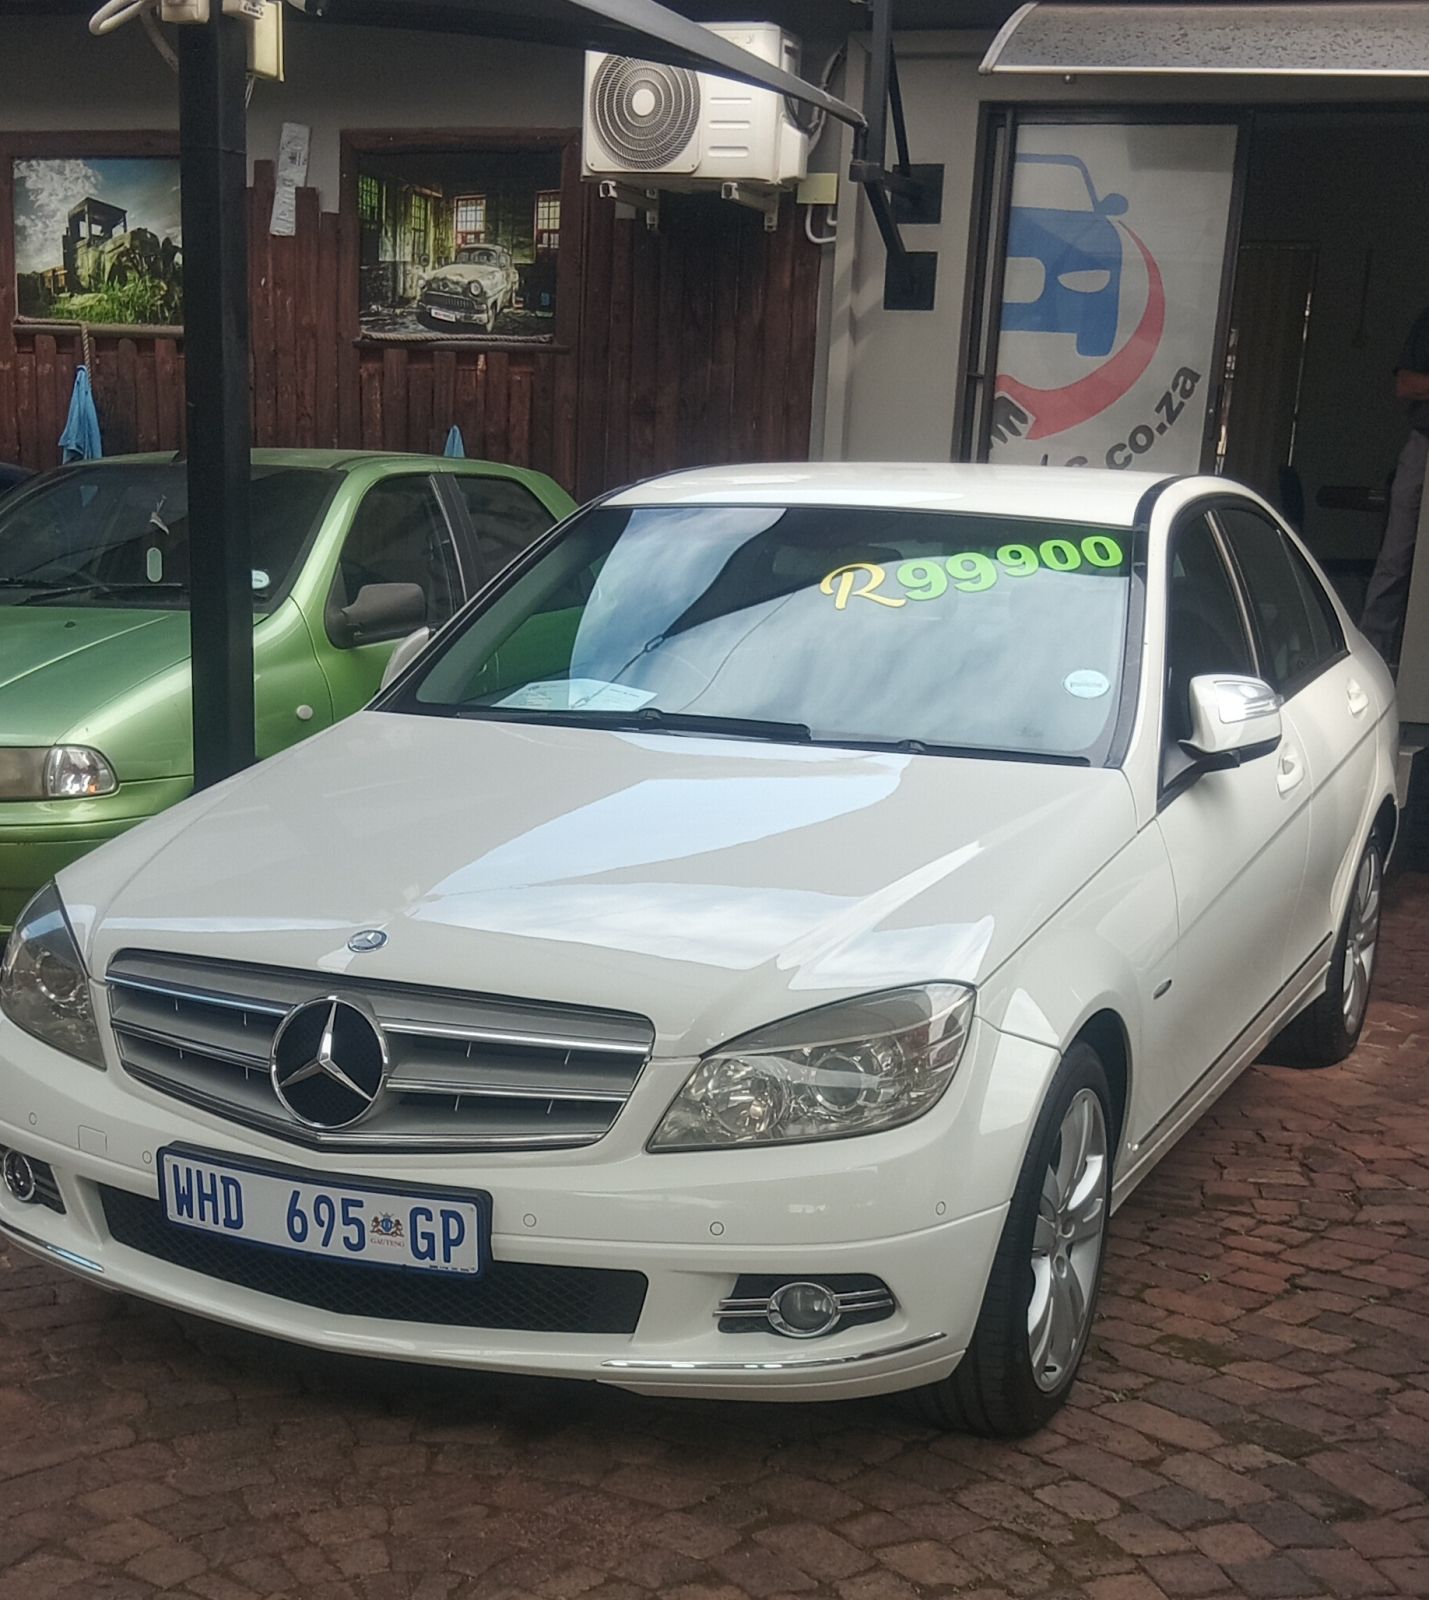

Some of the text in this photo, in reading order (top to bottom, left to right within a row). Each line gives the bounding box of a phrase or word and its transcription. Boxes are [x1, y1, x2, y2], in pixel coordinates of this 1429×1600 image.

[172, 1163, 465, 1264] WHD 695 GP
